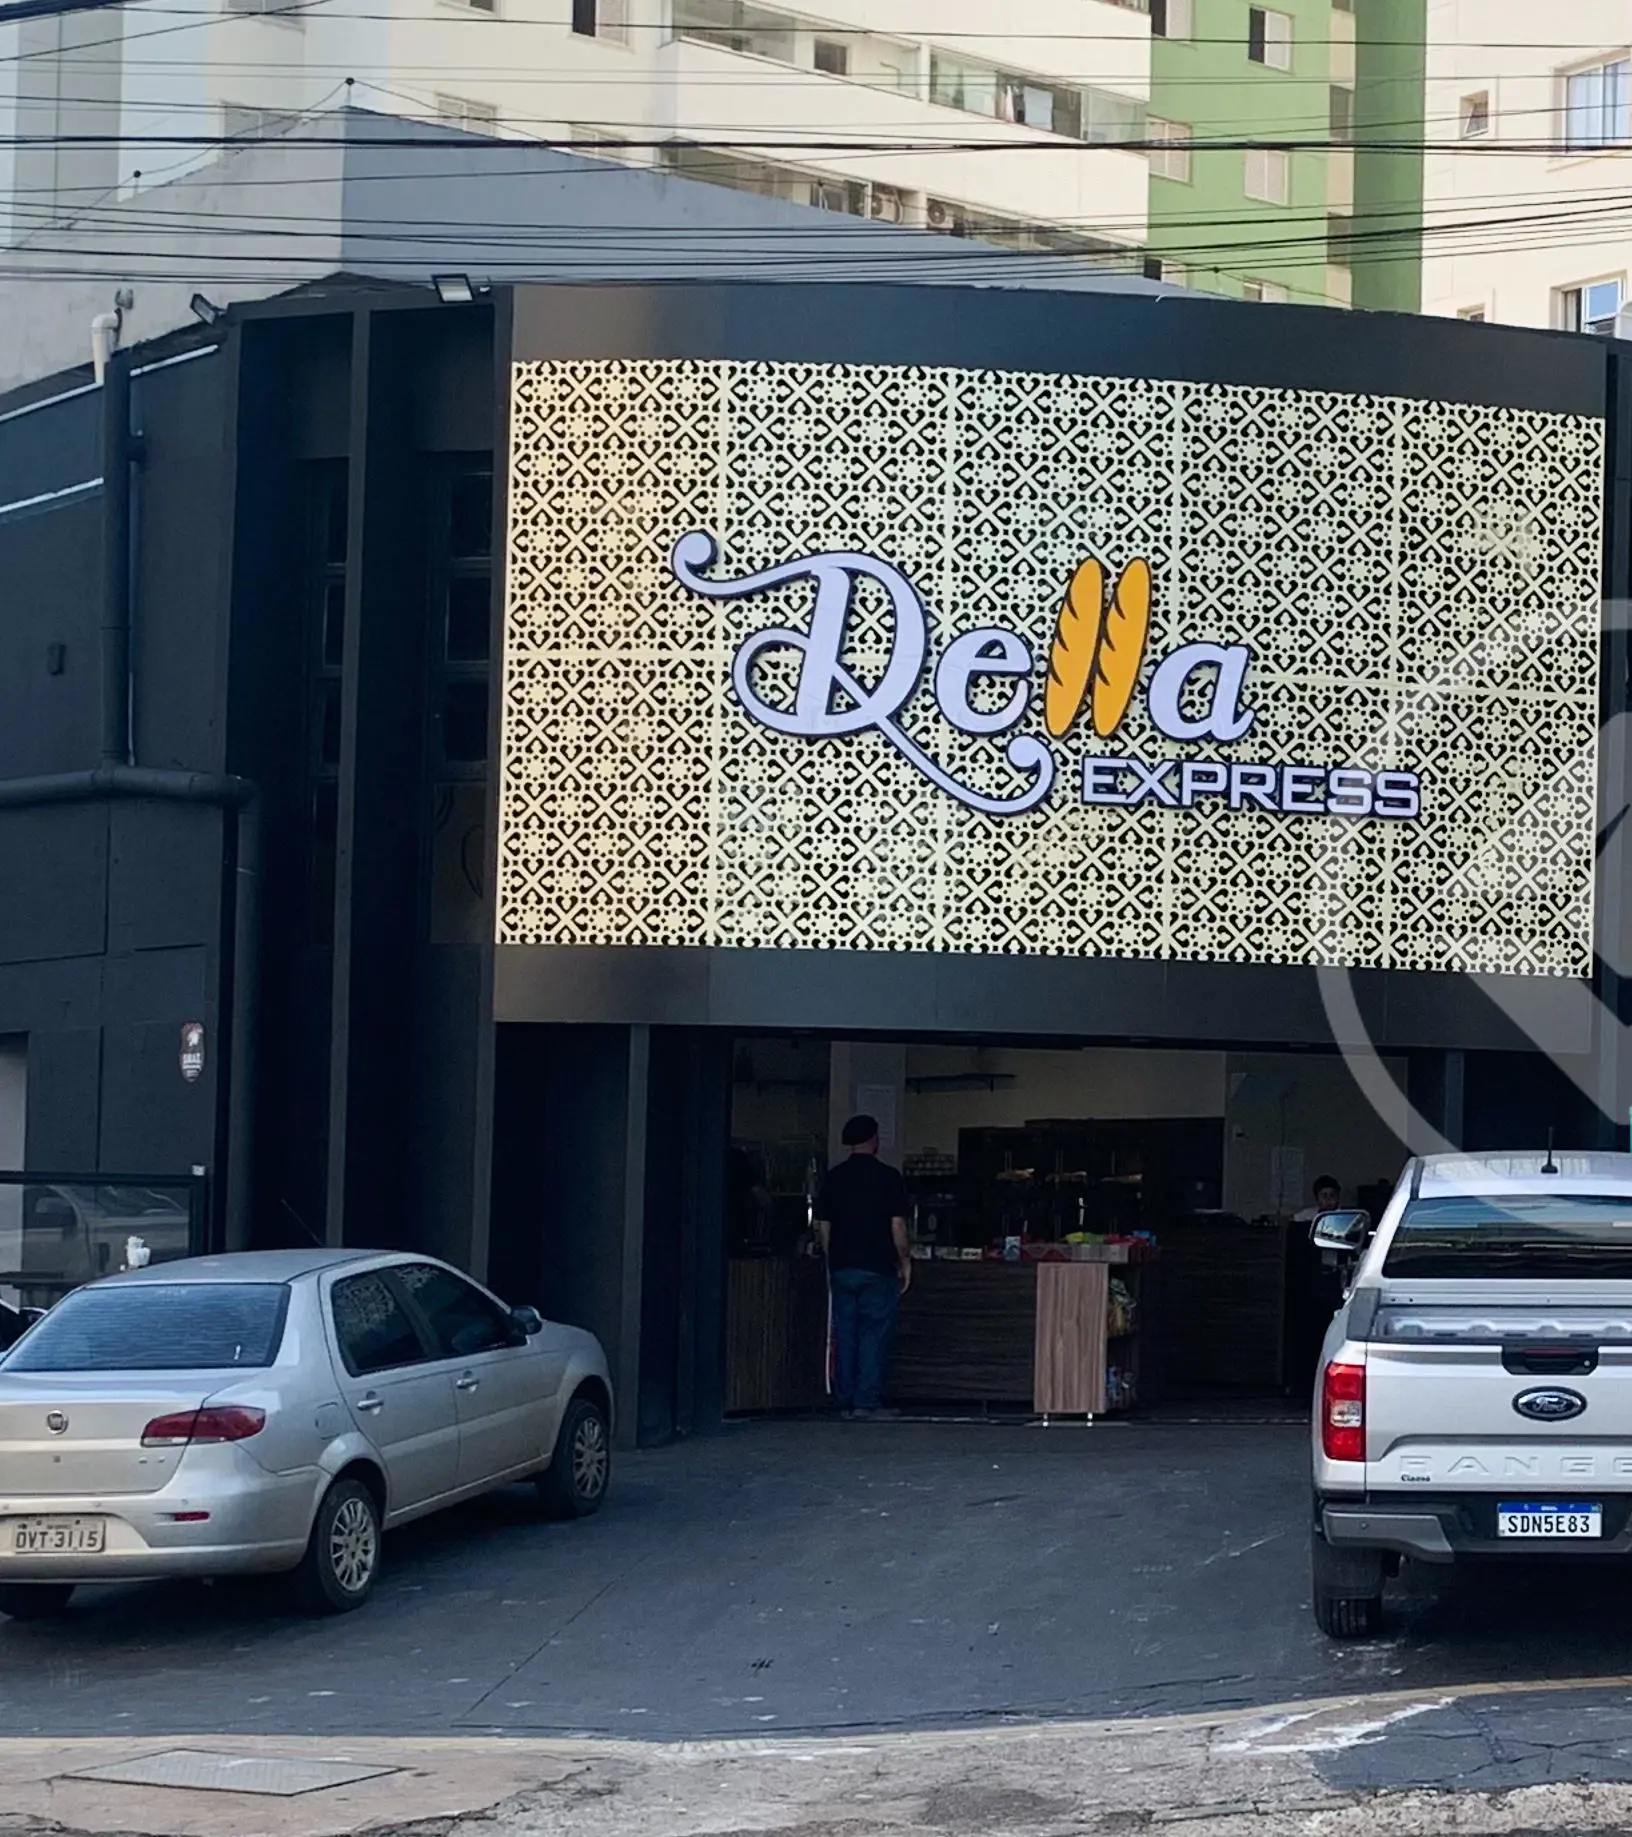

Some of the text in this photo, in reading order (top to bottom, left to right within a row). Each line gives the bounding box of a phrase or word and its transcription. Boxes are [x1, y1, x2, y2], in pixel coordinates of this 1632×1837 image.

[670, 529, 1259, 816] Della
[1081, 754, 1421, 818] EXPRESS
[1531, 1395, 1568, 1414] Ford
[1507, 1515, 1591, 1534] SDN5E83
